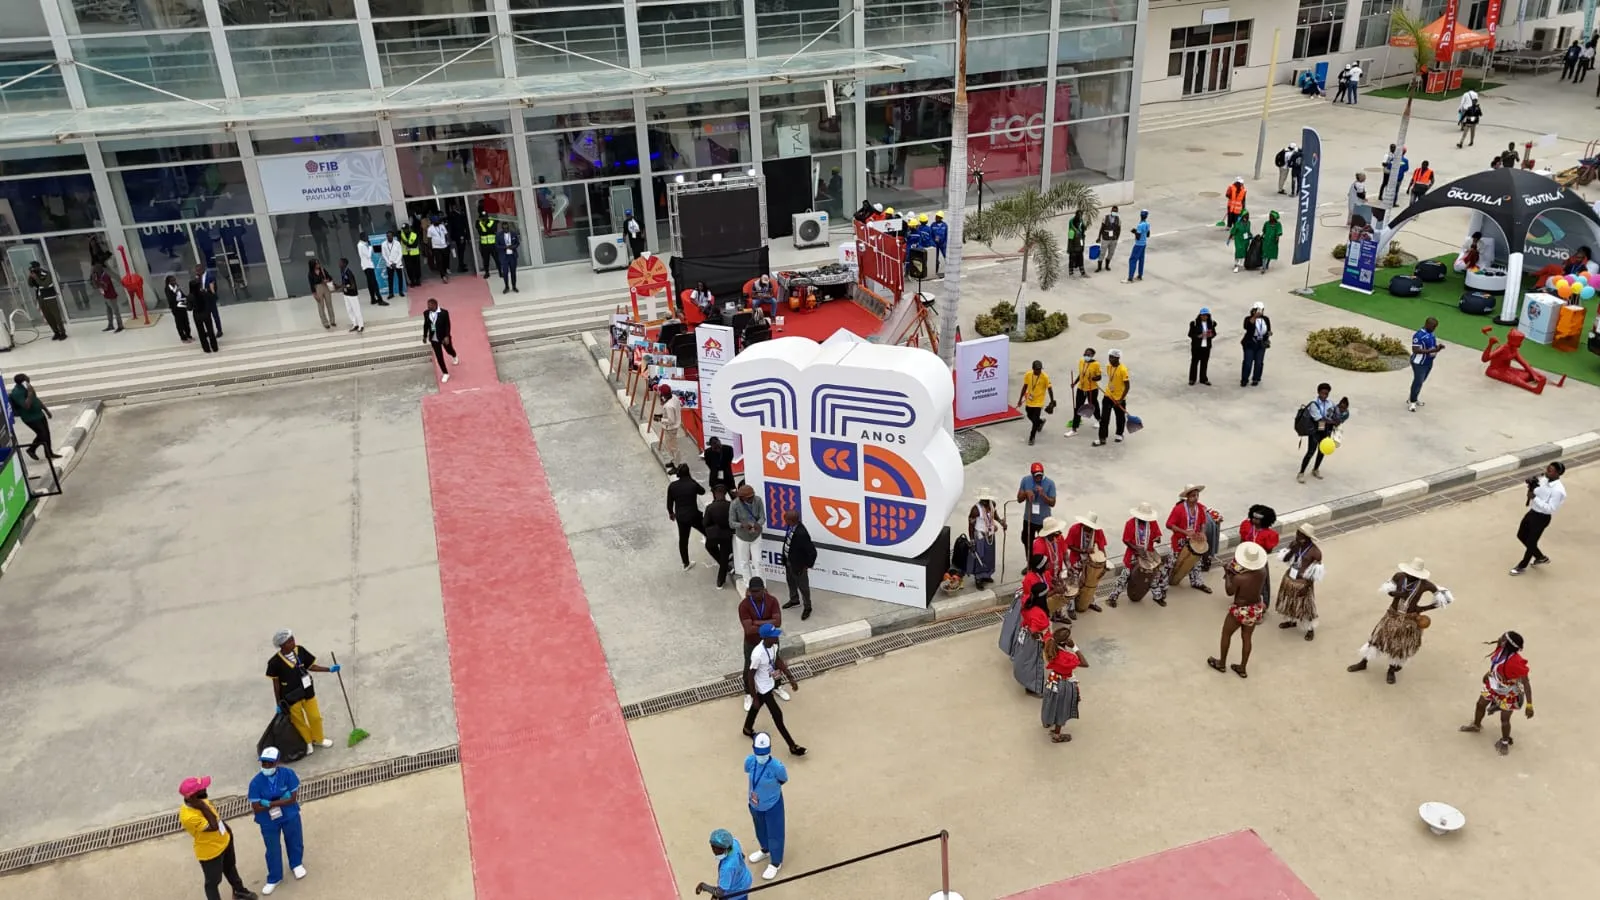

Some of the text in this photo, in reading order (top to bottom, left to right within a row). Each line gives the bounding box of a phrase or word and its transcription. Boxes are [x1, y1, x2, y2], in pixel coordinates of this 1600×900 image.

[319, 162, 339, 172] FIB
[302, 185, 341, 194] PAVILHÃO
[306, 193, 341, 201] PAVILION
[1447, 190, 1502, 206] OKUTALA
[1525, 190, 1564, 206] OKUTALA
[705, 350, 721, 359] FAS
[976, 369, 995, 380] FAS
[861, 430, 906, 444] ANOS
[761, 550, 784, 566] FIB
